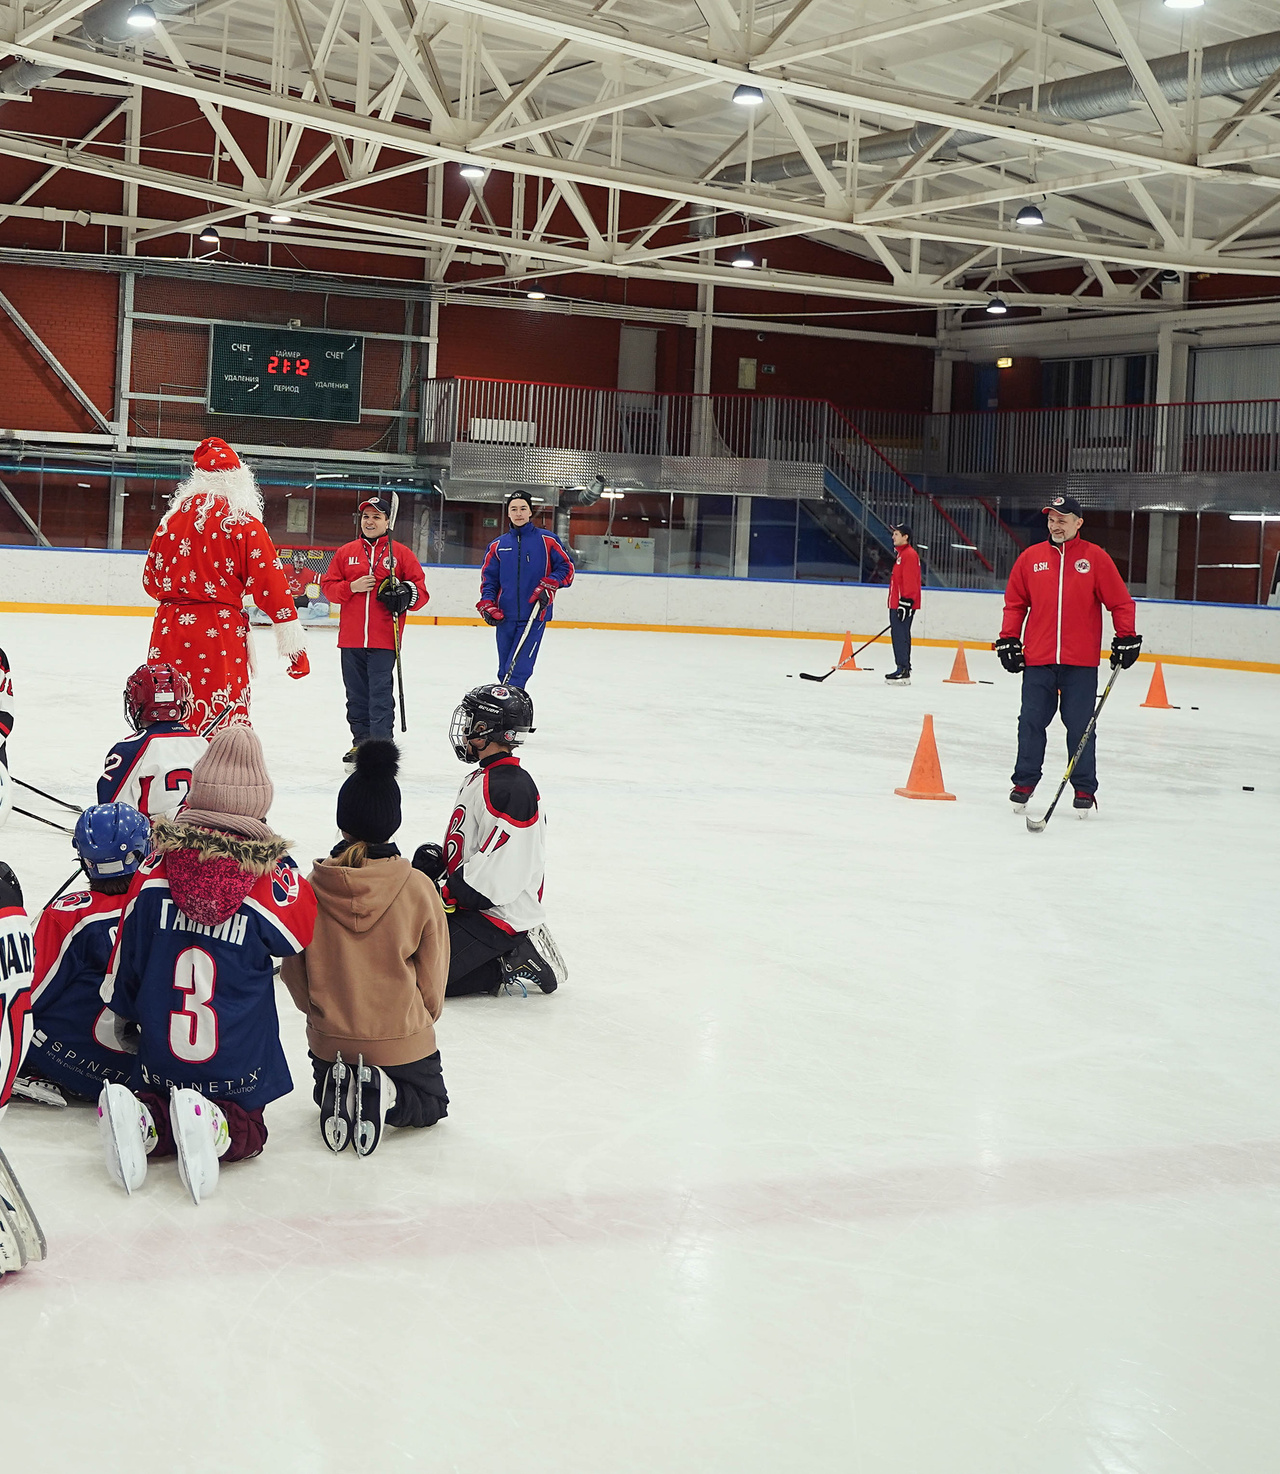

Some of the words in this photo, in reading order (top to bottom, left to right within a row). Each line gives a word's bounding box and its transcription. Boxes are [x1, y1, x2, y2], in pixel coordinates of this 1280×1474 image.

[231, 343, 251, 353] СЧЕТ
[275, 349, 301, 358] ТАЙМЕР
[325, 350, 344, 360] СЧЕТ
[268, 356, 310, 376] 21:12
[224, 374, 259, 383] УДАЛЕНИЯ
[273, 384, 300, 394] ПЕРИОД
[314, 381, 349, 389] УДАЛЕНИЯ
[169, 945, 219, 1064] 3
